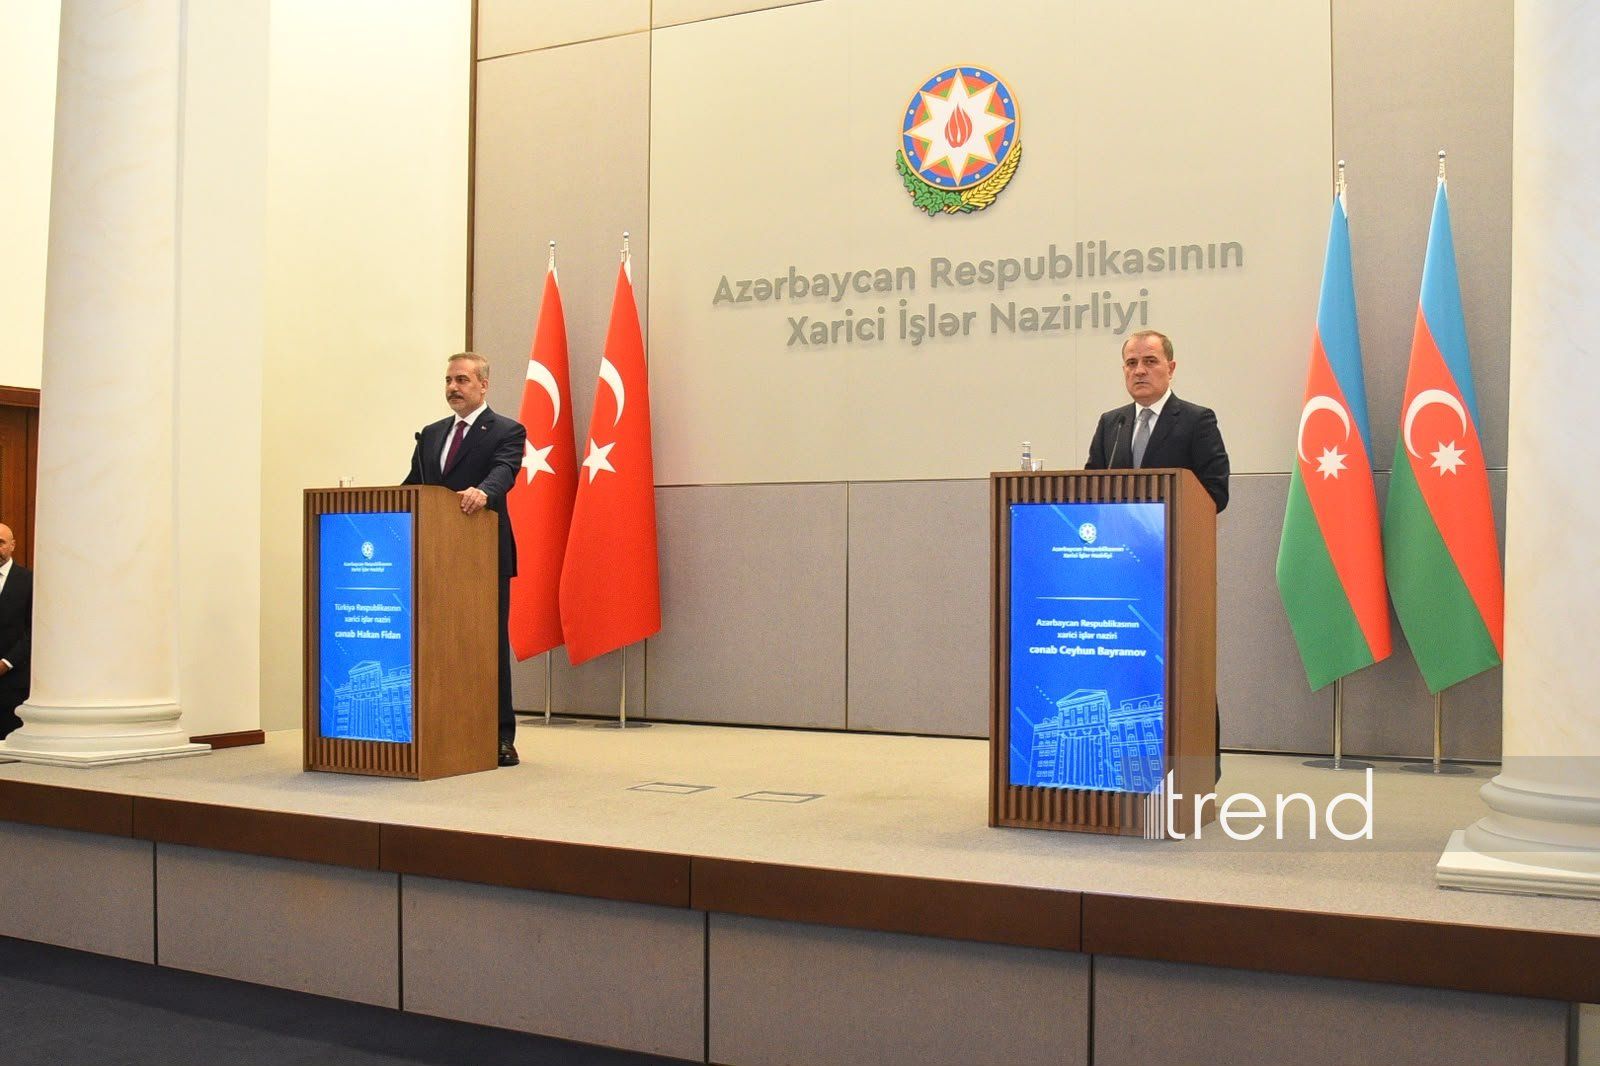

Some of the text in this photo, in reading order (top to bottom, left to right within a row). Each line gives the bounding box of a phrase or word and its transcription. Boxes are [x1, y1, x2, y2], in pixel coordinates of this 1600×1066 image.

[712, 240, 1243, 304] Azərbaycan Respublikasının
[786, 288, 1149, 346] Xarici İşlər Nazirliyi
[357, 630, 380, 639] Hakan
[381, 630, 401, 640] Fidan
[1059, 645, 1096, 657] Ceyhun
[1097, 646, 1147, 658] Bayramov
